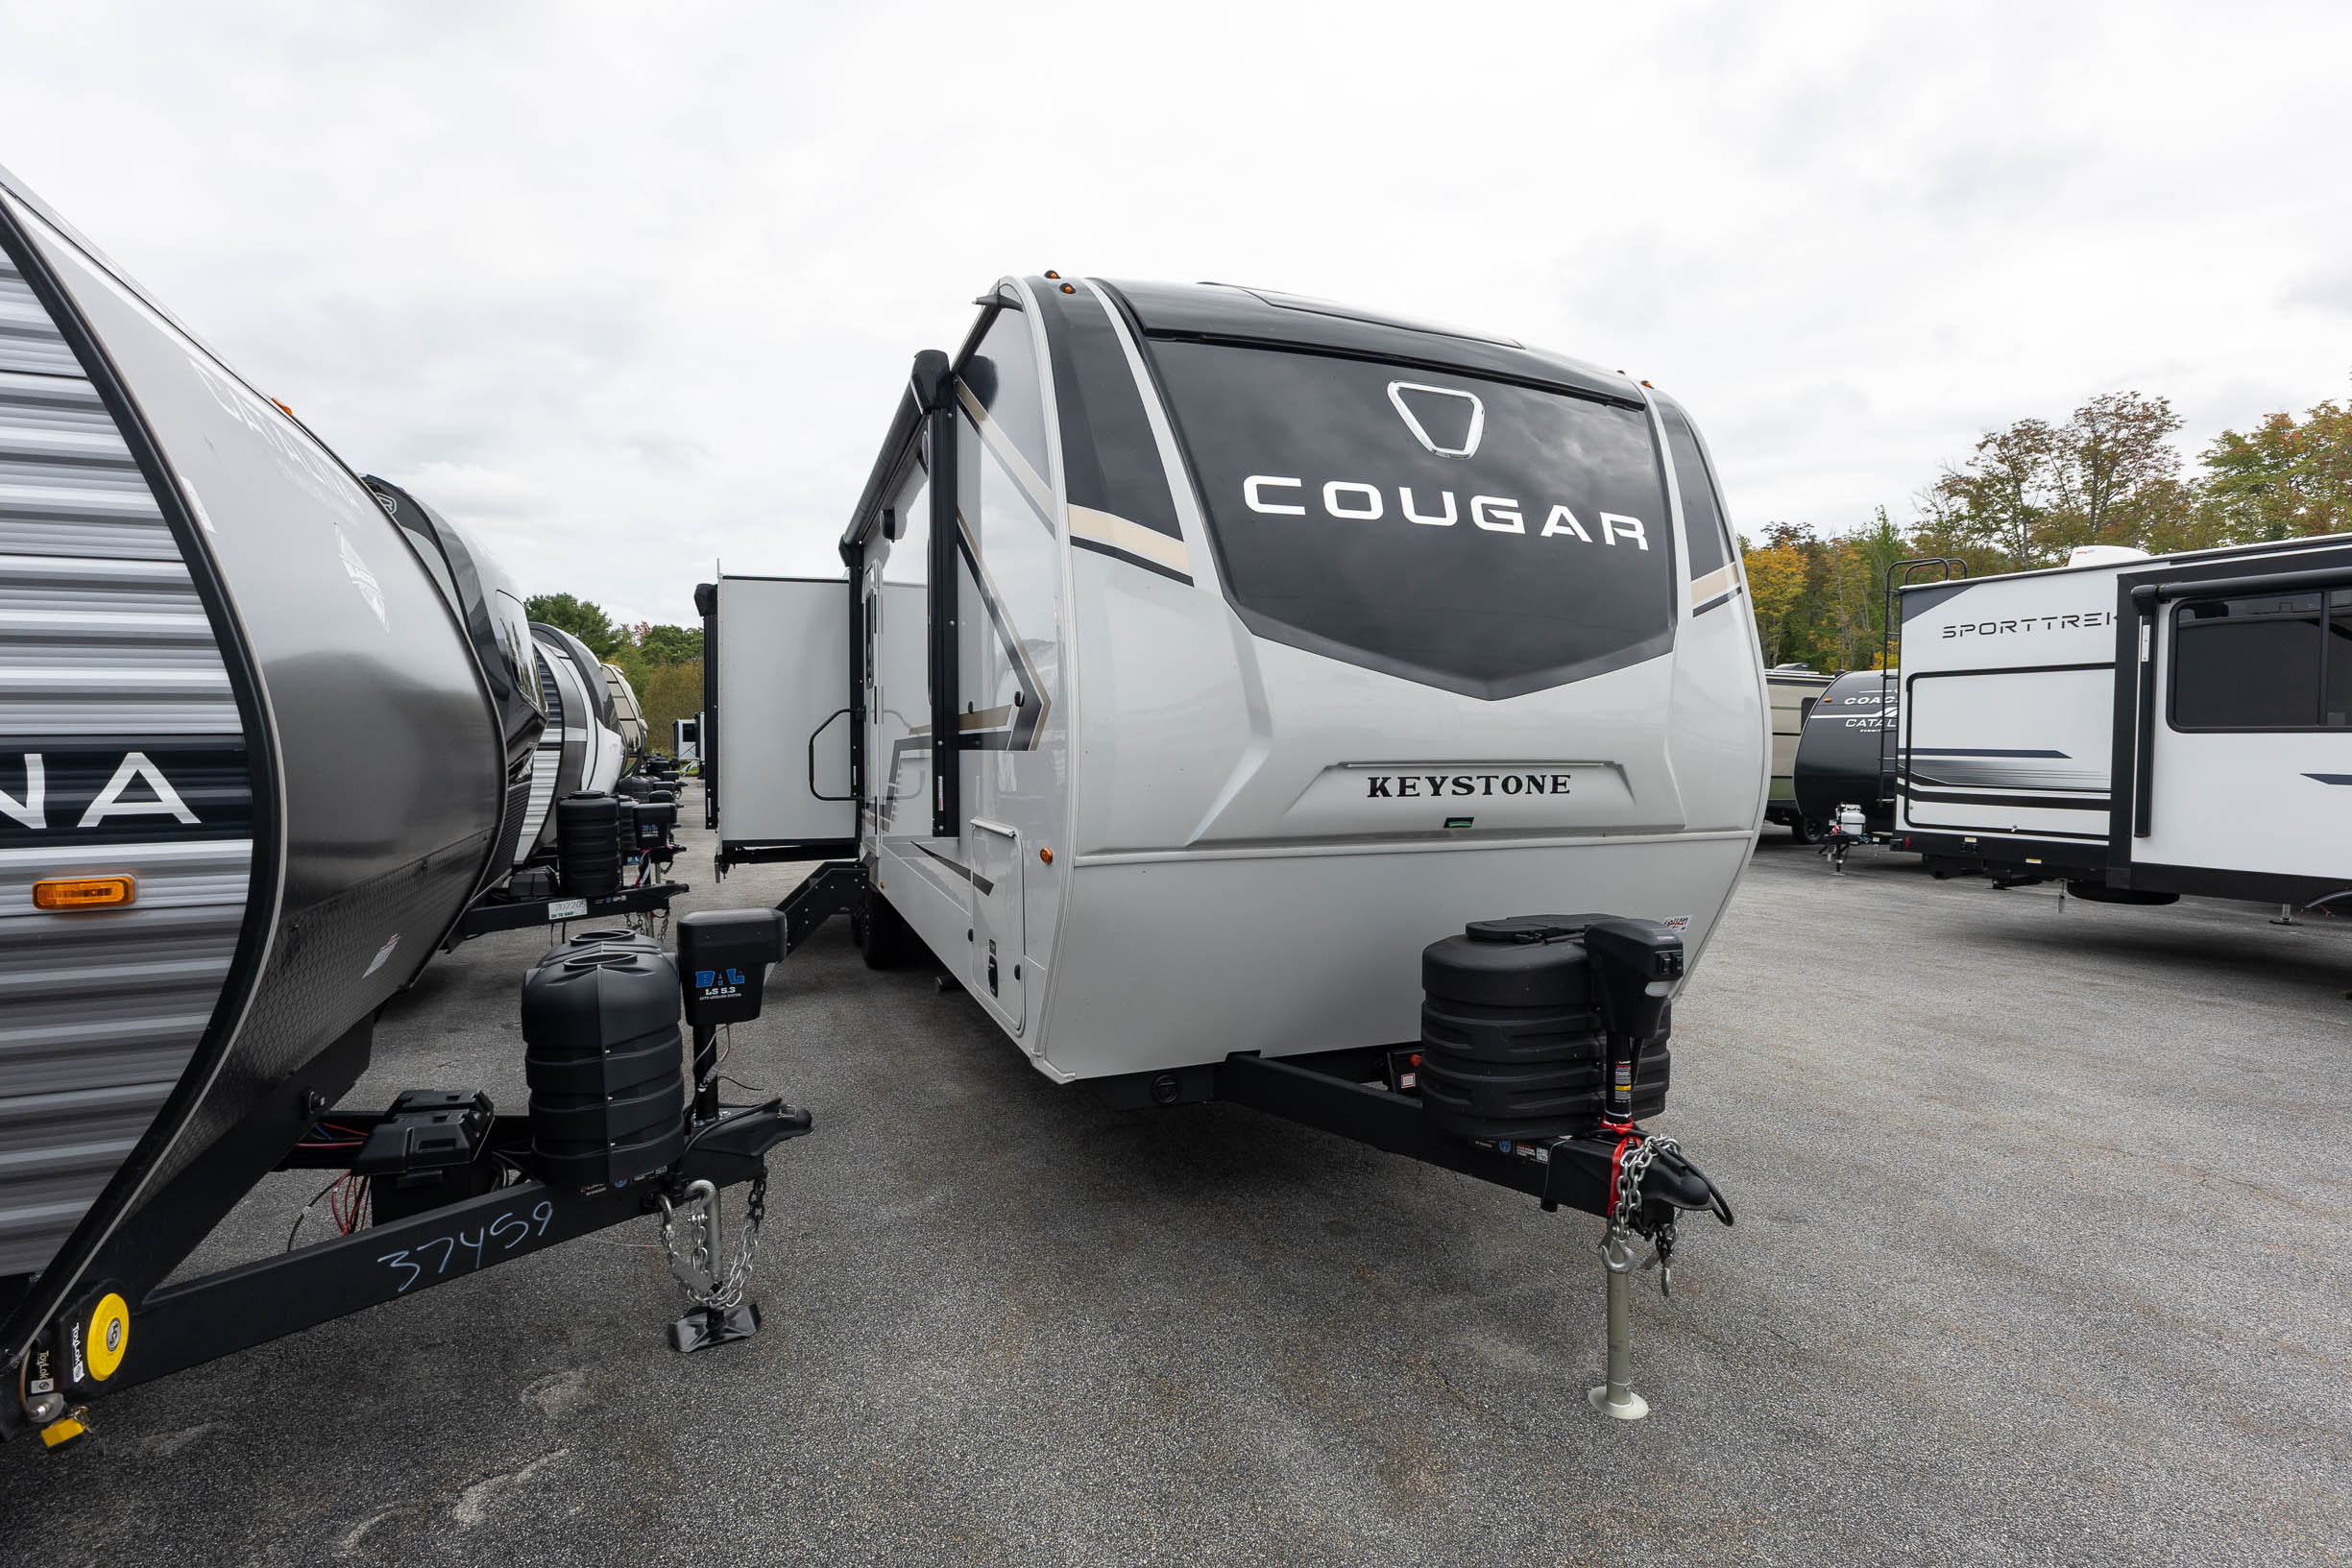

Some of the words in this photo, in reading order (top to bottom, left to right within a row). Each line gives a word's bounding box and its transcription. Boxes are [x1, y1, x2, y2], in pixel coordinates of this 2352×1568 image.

[1243, 474, 1649, 551] COUGAR
[1844, 696, 1898, 705] COAC
[1367, 774, 1571, 798] KEYSTONE
[377, 1200, 553, 1292] 37459
